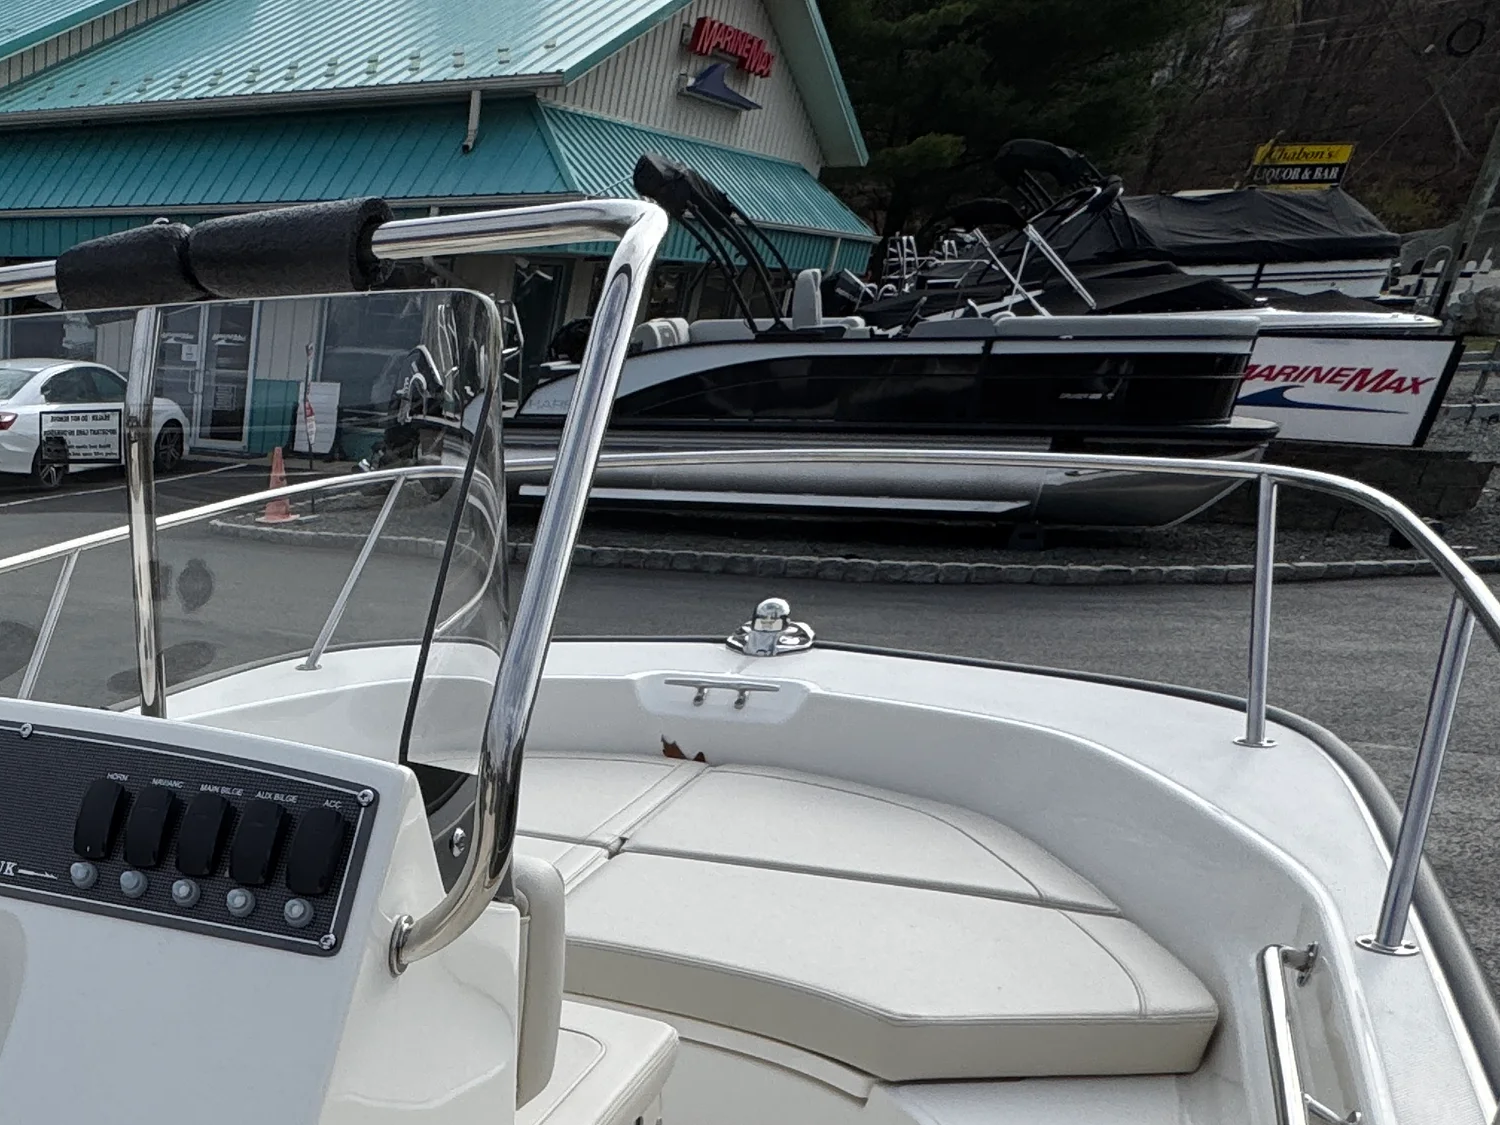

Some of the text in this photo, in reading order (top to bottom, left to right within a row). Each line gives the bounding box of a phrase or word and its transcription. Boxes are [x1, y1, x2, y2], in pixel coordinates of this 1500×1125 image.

[1253, 167, 1301, 180] LIQUOR
[1313, 166, 1340, 180] BAR
[106, 772, 129, 782] HORN
[200, 783, 245, 797] MAIN BILGE
[256, 790, 299, 804] AUX BILGE
[323, 799, 343, 809] ACC
